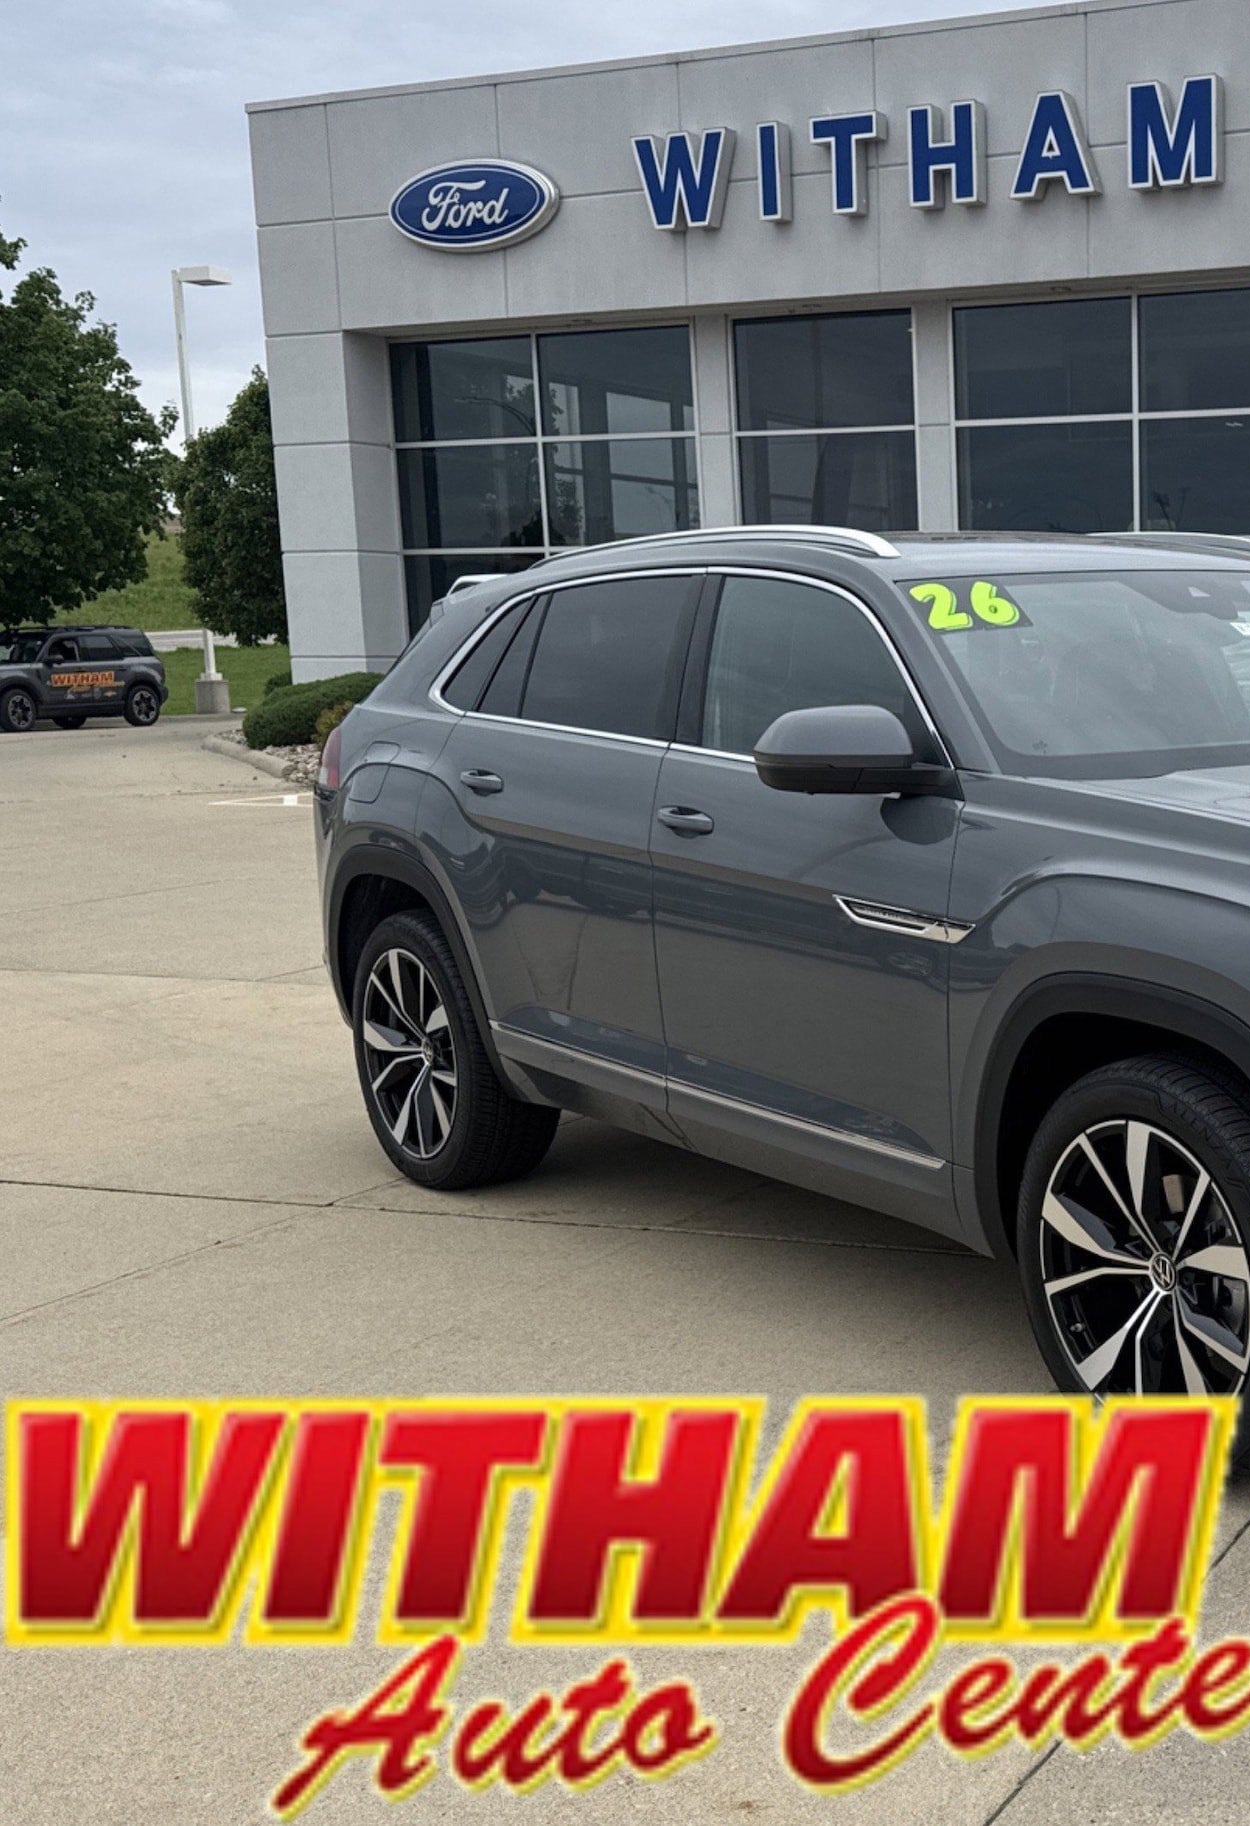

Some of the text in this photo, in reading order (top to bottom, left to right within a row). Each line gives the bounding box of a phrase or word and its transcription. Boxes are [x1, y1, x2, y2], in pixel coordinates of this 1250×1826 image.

[631, 74, 1223, 231] WITHAM
[420, 179, 510, 232] Ford
[909, 580, 1020, 631] 26
[52, 672, 114, 687] WITHAM
